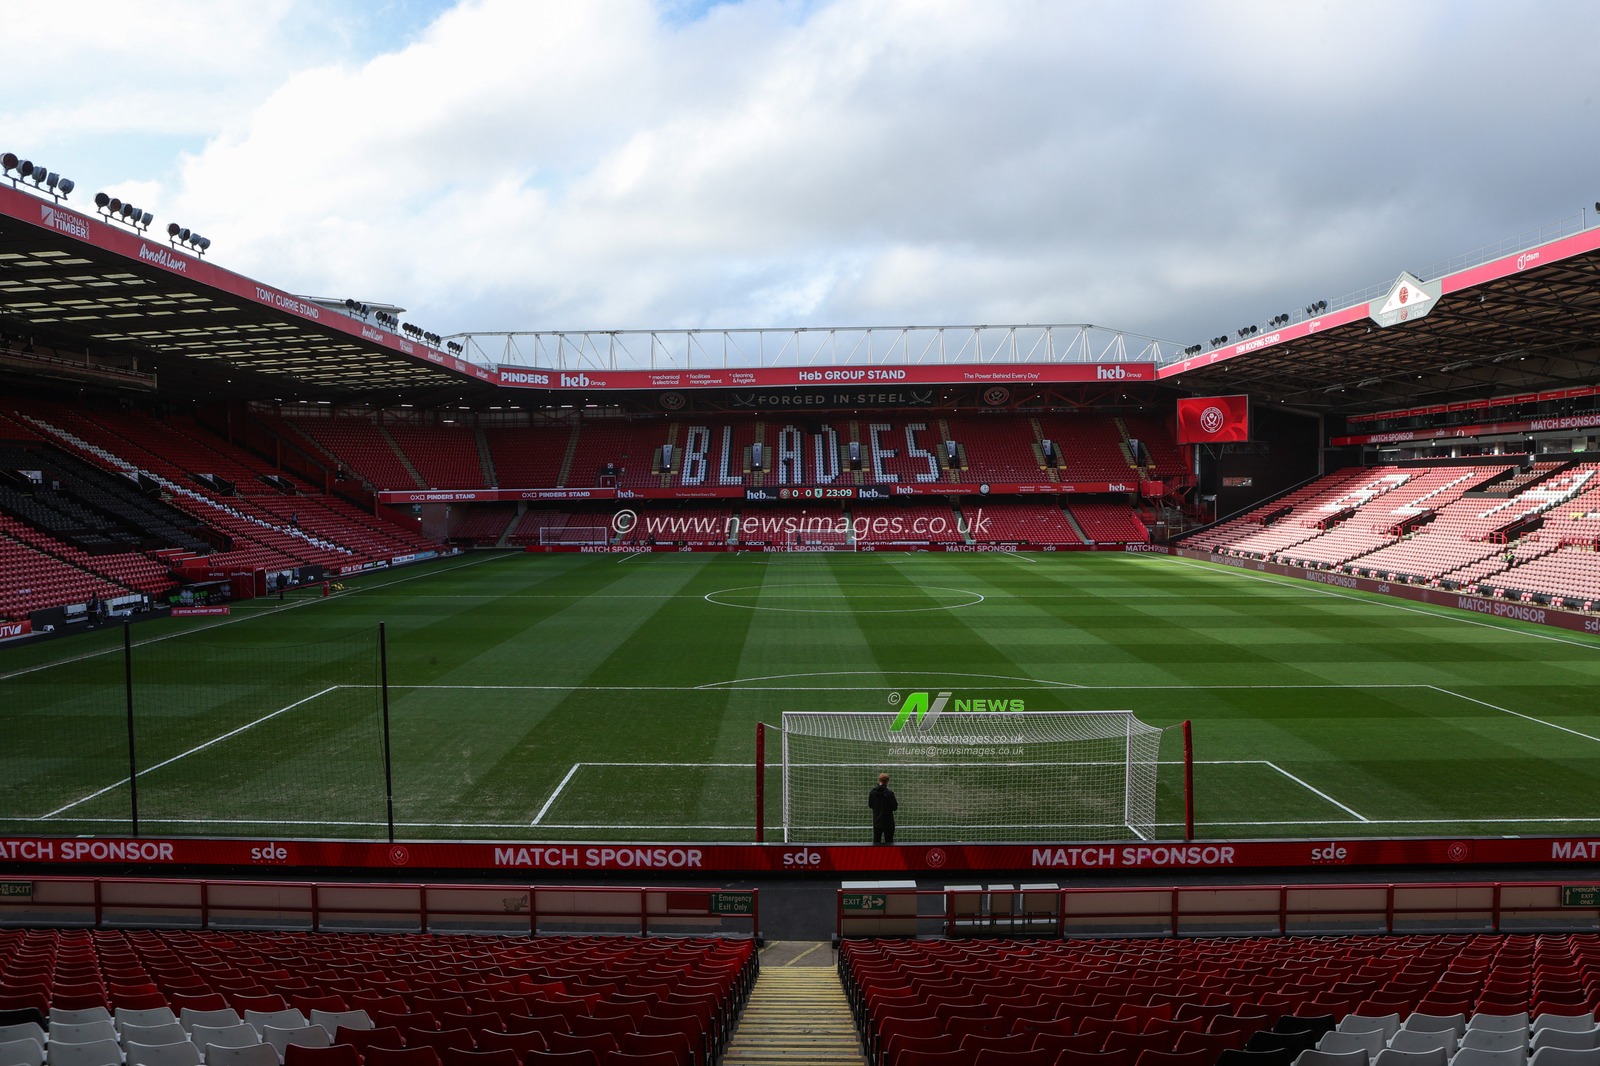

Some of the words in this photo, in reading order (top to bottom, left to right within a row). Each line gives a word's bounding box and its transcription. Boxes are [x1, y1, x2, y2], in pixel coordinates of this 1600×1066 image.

[55, 209, 86, 229] NATIONAL
[54, 218, 86, 239] TIMBER
[139, 243, 166, 266] Arnold
[166, 254, 187, 272] Laver
[1526, 252, 1540, 262] dsm
[256, 286, 275, 302] TONY
[276, 294, 299, 313] CURRIE
[300, 303, 318, 319] STAND
[1245, 339, 1264, 352] ROOFING
[1265, 334, 1280, 346] STAND
[500, 372, 549, 384] PINDERS
[799, 371, 822, 380] Heb
[824, 370, 865, 380] GROUP
[867, 370, 906, 379] STAND
[1097, 365, 1125, 379] heb
[560, 373, 590, 387] heb
[758, 395, 825, 405] FORGED
[833, 394, 850, 404] IN
[858, 393, 906, 403] STEEL
[1531, 420, 1558, 430] MATCH
[1560, 416, 1600, 428] SPONSOR
[1371, 434, 1388, 443] MATCH
[1389, 432, 1414, 441] SPONSOR
[681, 424, 940, 486] BLADES
[747, 490, 766, 499] heb
[859, 489, 878, 498] heb
[896, 486, 913, 494] heb
[1210, 555, 1224, 565] MATCH
[1224, 556, 1244, 568] SPONSOR
[1307, 571, 1326, 582] MATCH
[1327, 574, 1357, 588] SPONSOR
[1378, 583, 1390, 592] sde
[1458, 596, 1492, 613] MATCH
[1494, 603, 1545, 623] SPONSOR
[1585, 618, 1600, 631] sd
[0, 842, 53, 859] ATCH
[61, 842, 173, 860] SPONSOR
[251, 842, 287, 859] sde
[783, 848, 821, 864] sde
[1032, 848, 1115, 866] MATCH
[1121, 847, 1234, 865] SPONSOR
[1311, 842, 1347, 860] sde
[1552, 842, 1600, 858] MAT
[494, 848, 578, 866] MATCH
[586, 848, 702, 867] SPONSOR
[719, 894, 752, 903] Emergency
[734, 904, 747, 912] Only
